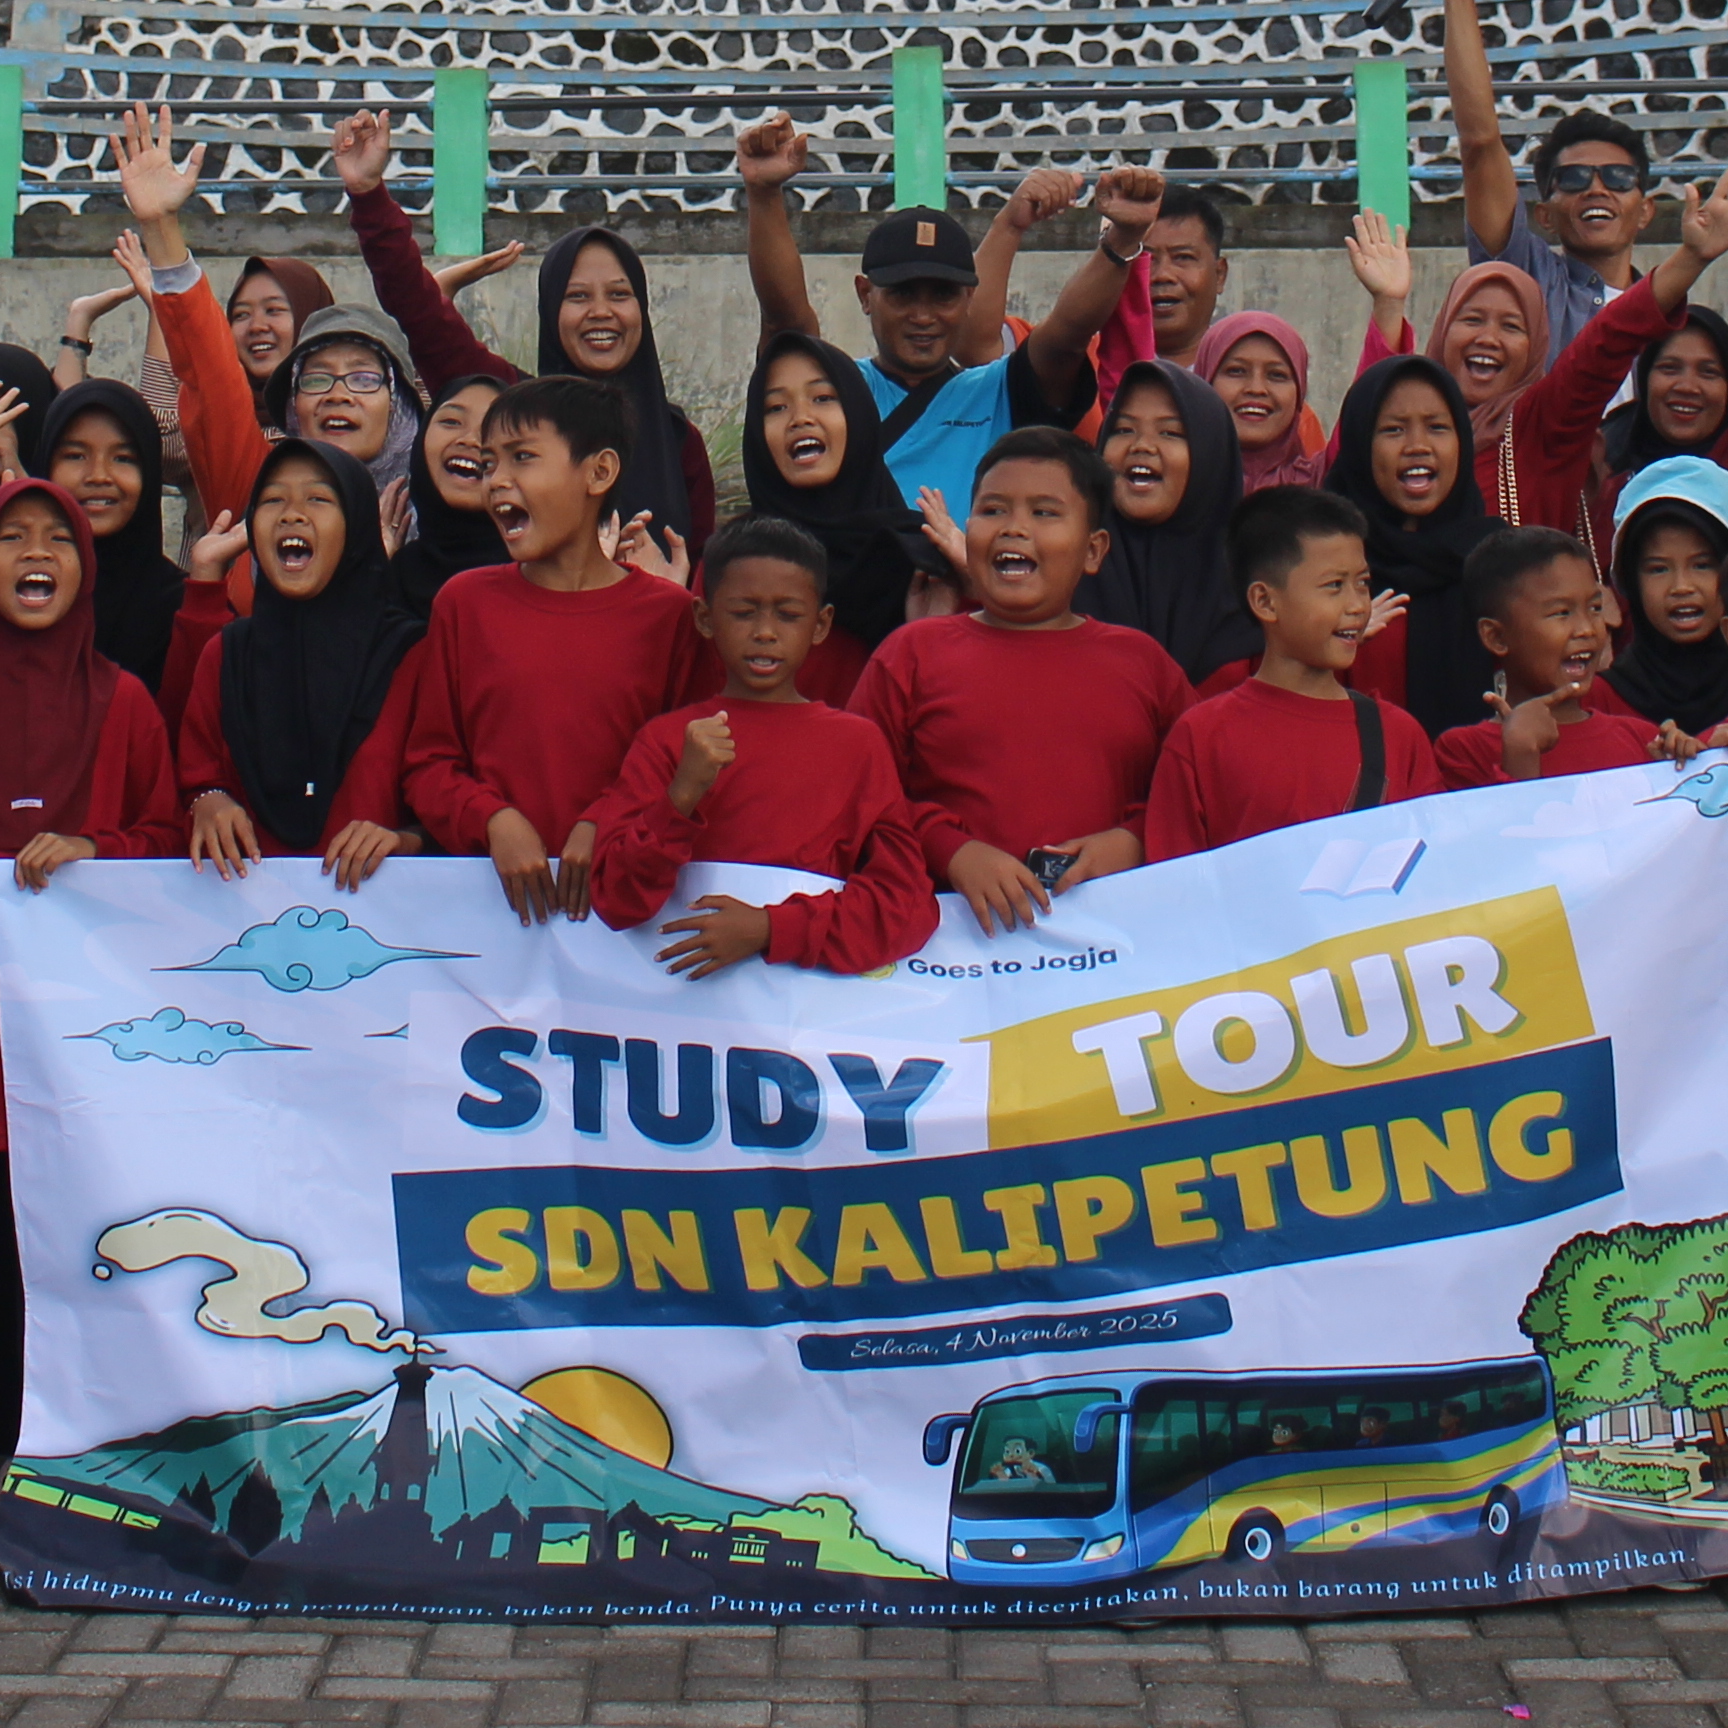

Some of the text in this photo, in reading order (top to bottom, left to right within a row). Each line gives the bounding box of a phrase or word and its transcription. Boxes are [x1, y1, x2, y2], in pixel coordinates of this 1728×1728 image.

[907, 946, 1118, 979] Goes to Jogja
[457, 936, 1520, 1152] STUDY TOUR
[463, 1090, 1576, 1295] SDN KALIPETUNG
[849, 1309, 1180, 1359] Selasa, 4 November 2025
[42, 1570, 174, 1602] hidupmu
[184, 1589, 290, 1612] dengan
[504, 1604, 594, 1617] bukan
[710, 1594, 803, 1617] Punya
[813, 1599, 898, 1616] cerita
[908, 1600, 997, 1616] untuk
[1007, 1587, 1190, 1615] diceritakan,
[1199, 1578, 1288, 1599] bukan
[1297, 1579, 1401, 1600] barang
[1410, 1571, 1498, 1594] untuk
[1506, 1547, 1696, 1587] ditampilkan.
